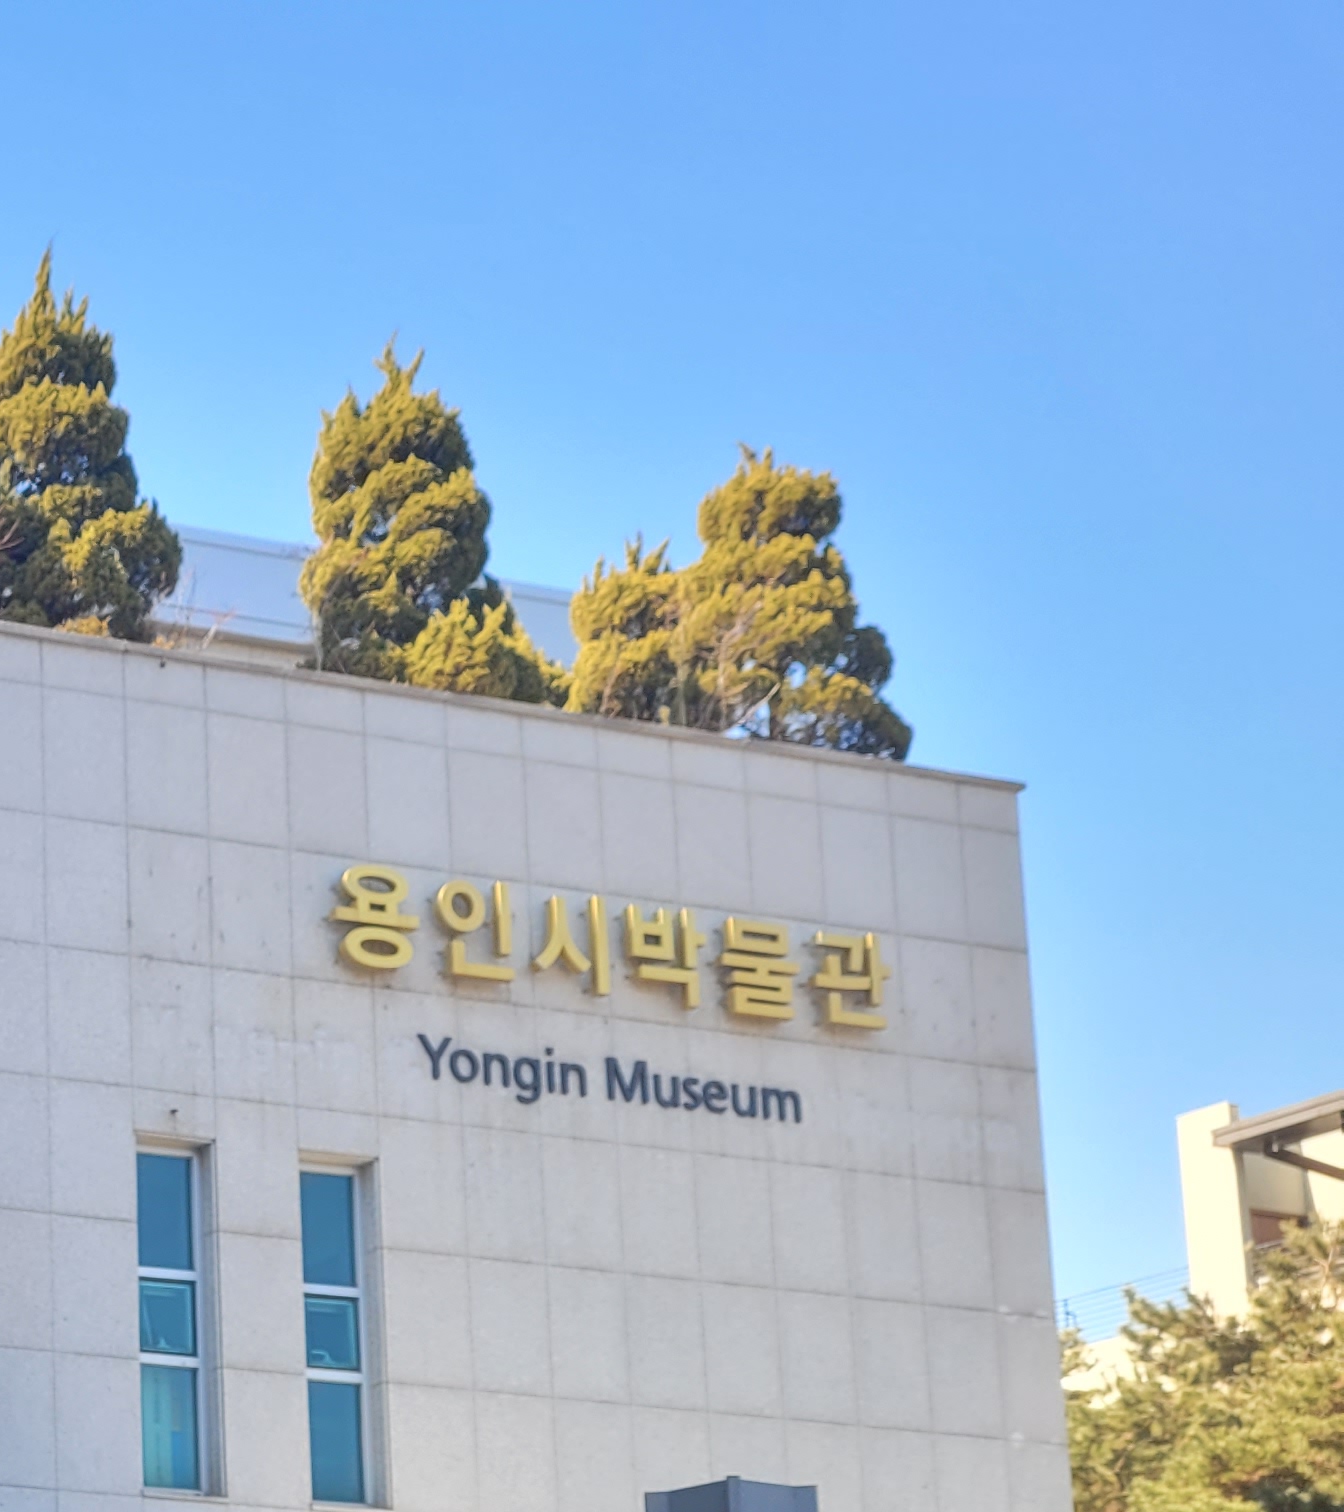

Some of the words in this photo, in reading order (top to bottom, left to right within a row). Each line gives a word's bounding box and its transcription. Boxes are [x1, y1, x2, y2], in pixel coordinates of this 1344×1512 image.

[330, 864, 890, 1030] 용인시박물관
[417, 1033, 587, 1104] Yongin
[605, 1056, 802, 1123] Museum
